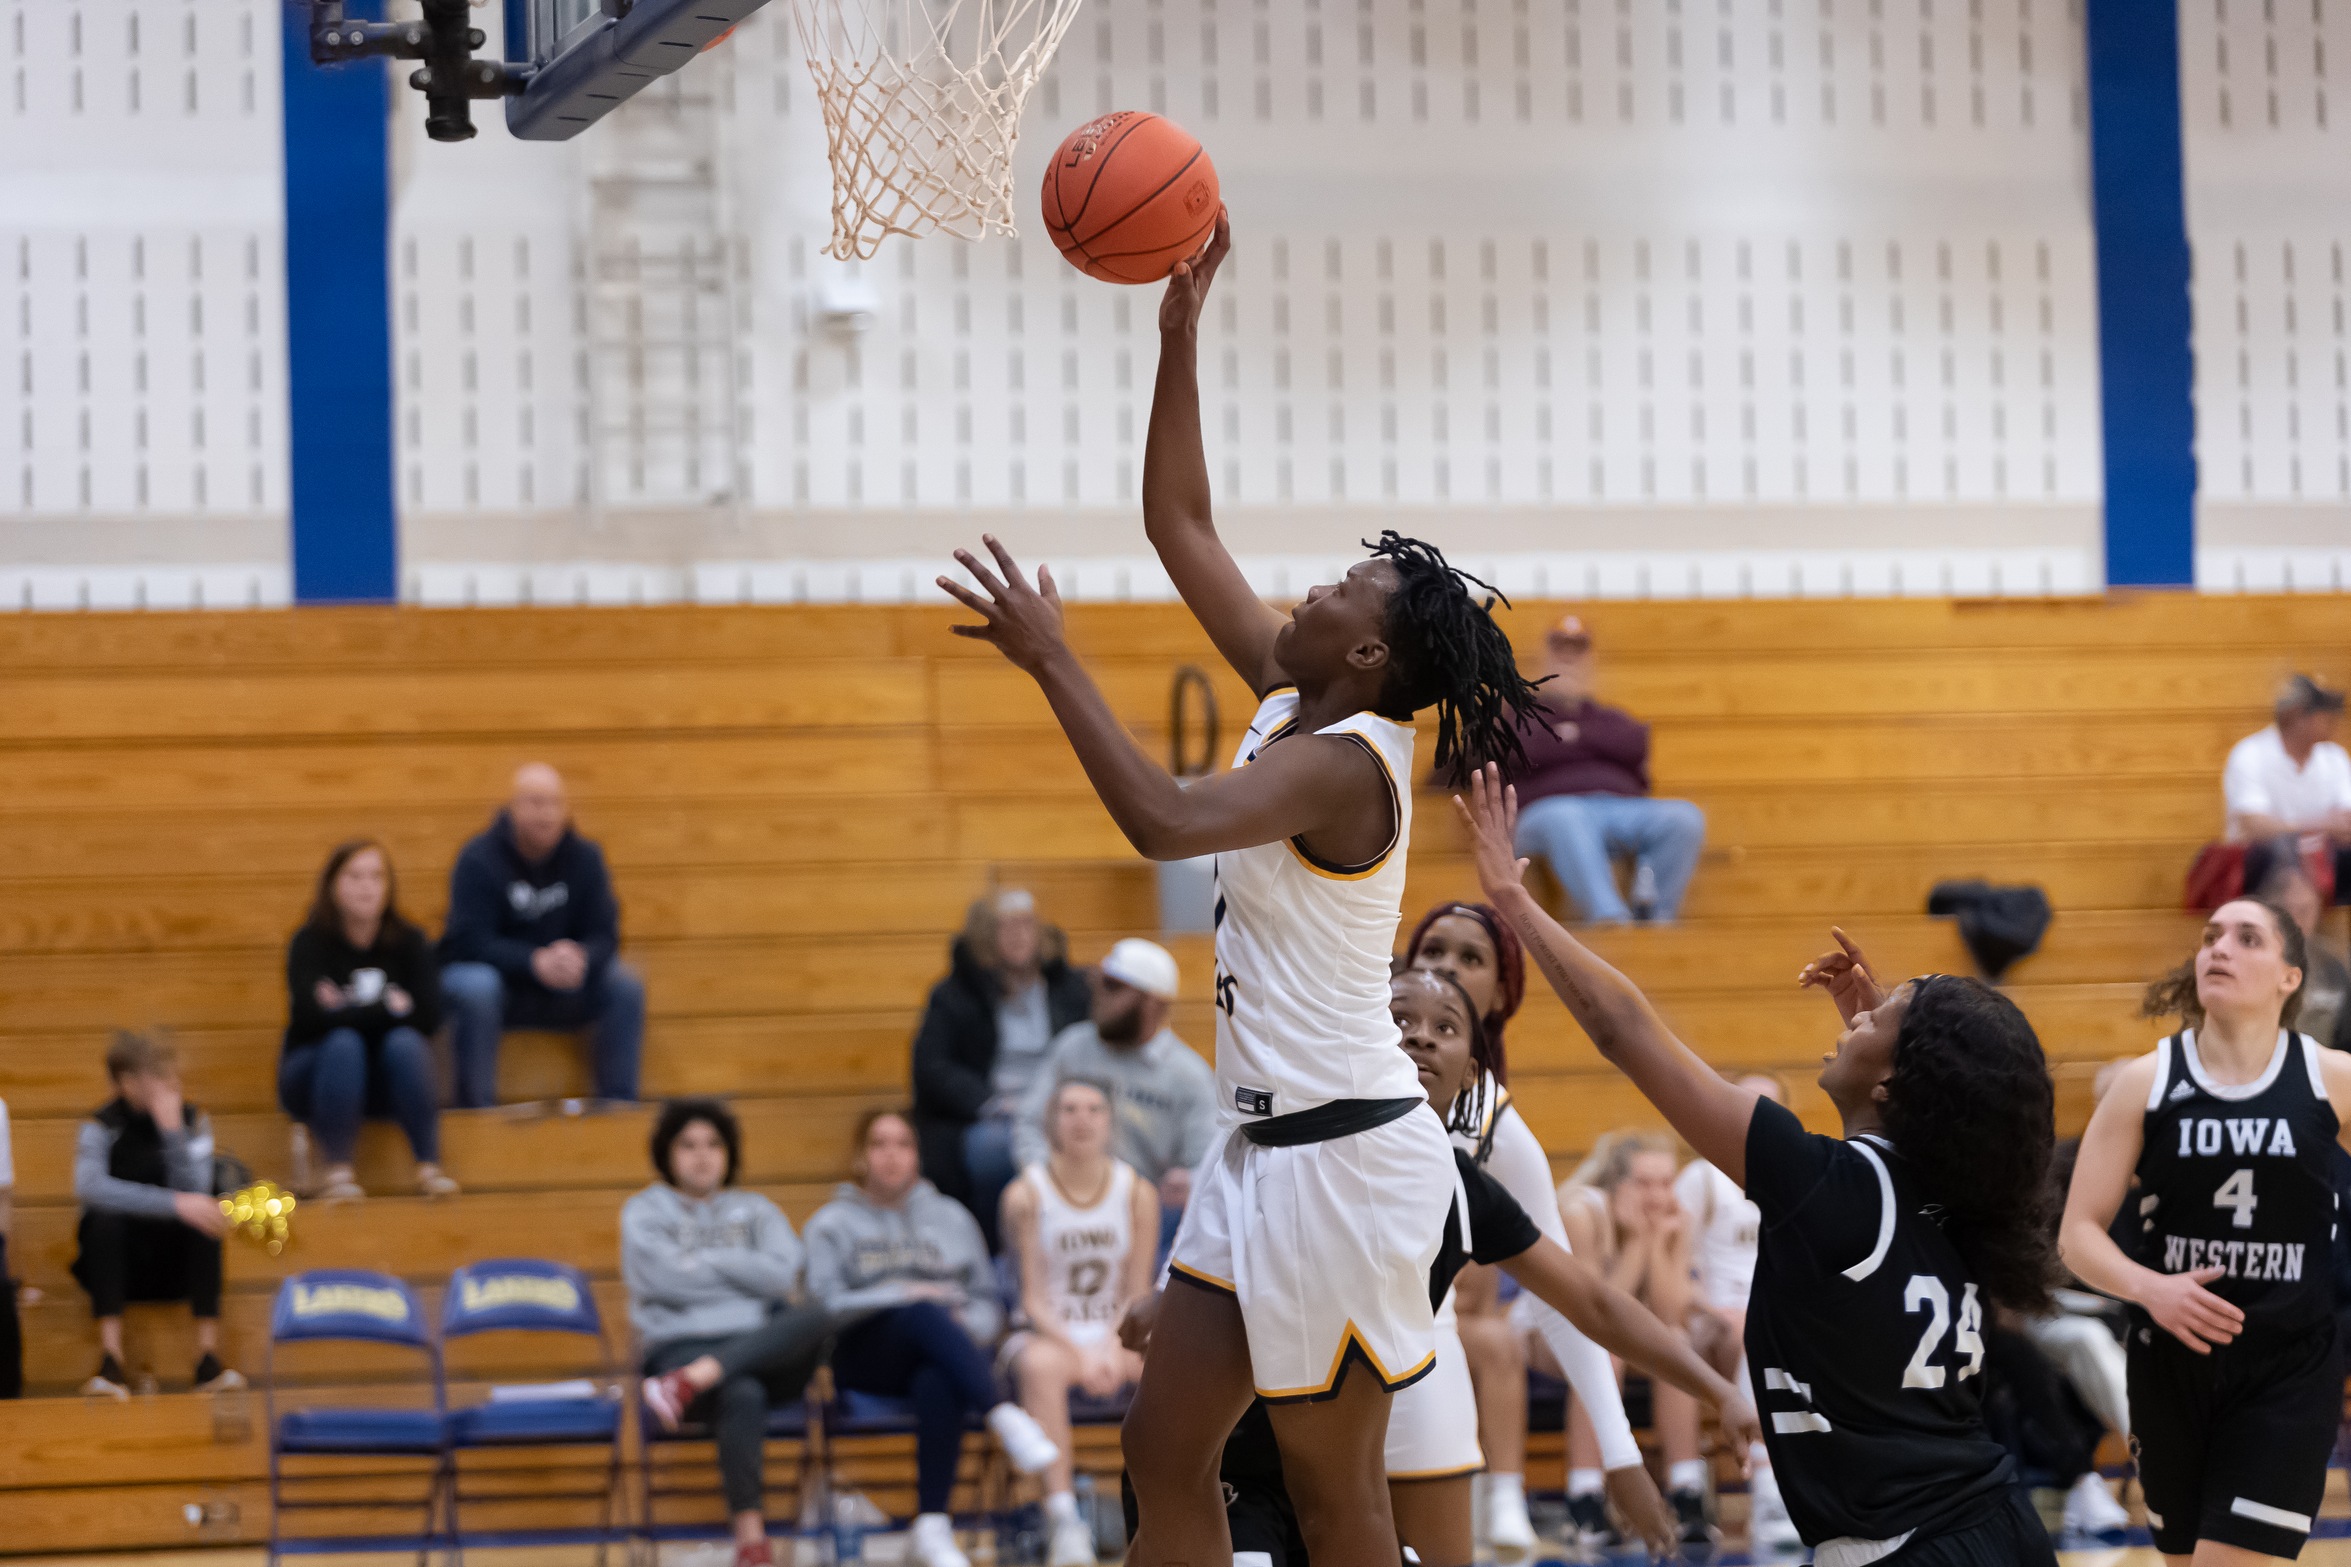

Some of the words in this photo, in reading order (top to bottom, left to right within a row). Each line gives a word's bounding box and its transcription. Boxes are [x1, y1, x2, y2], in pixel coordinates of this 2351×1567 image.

[1259, 1099, 1266, 1110] S
[2177, 1117, 2297, 1158] IOWA
[2212, 1168, 2258, 1229] 4
[2163, 1234, 2306, 1282] WESTERN
[1901, 1273, 1986, 1390] 24
